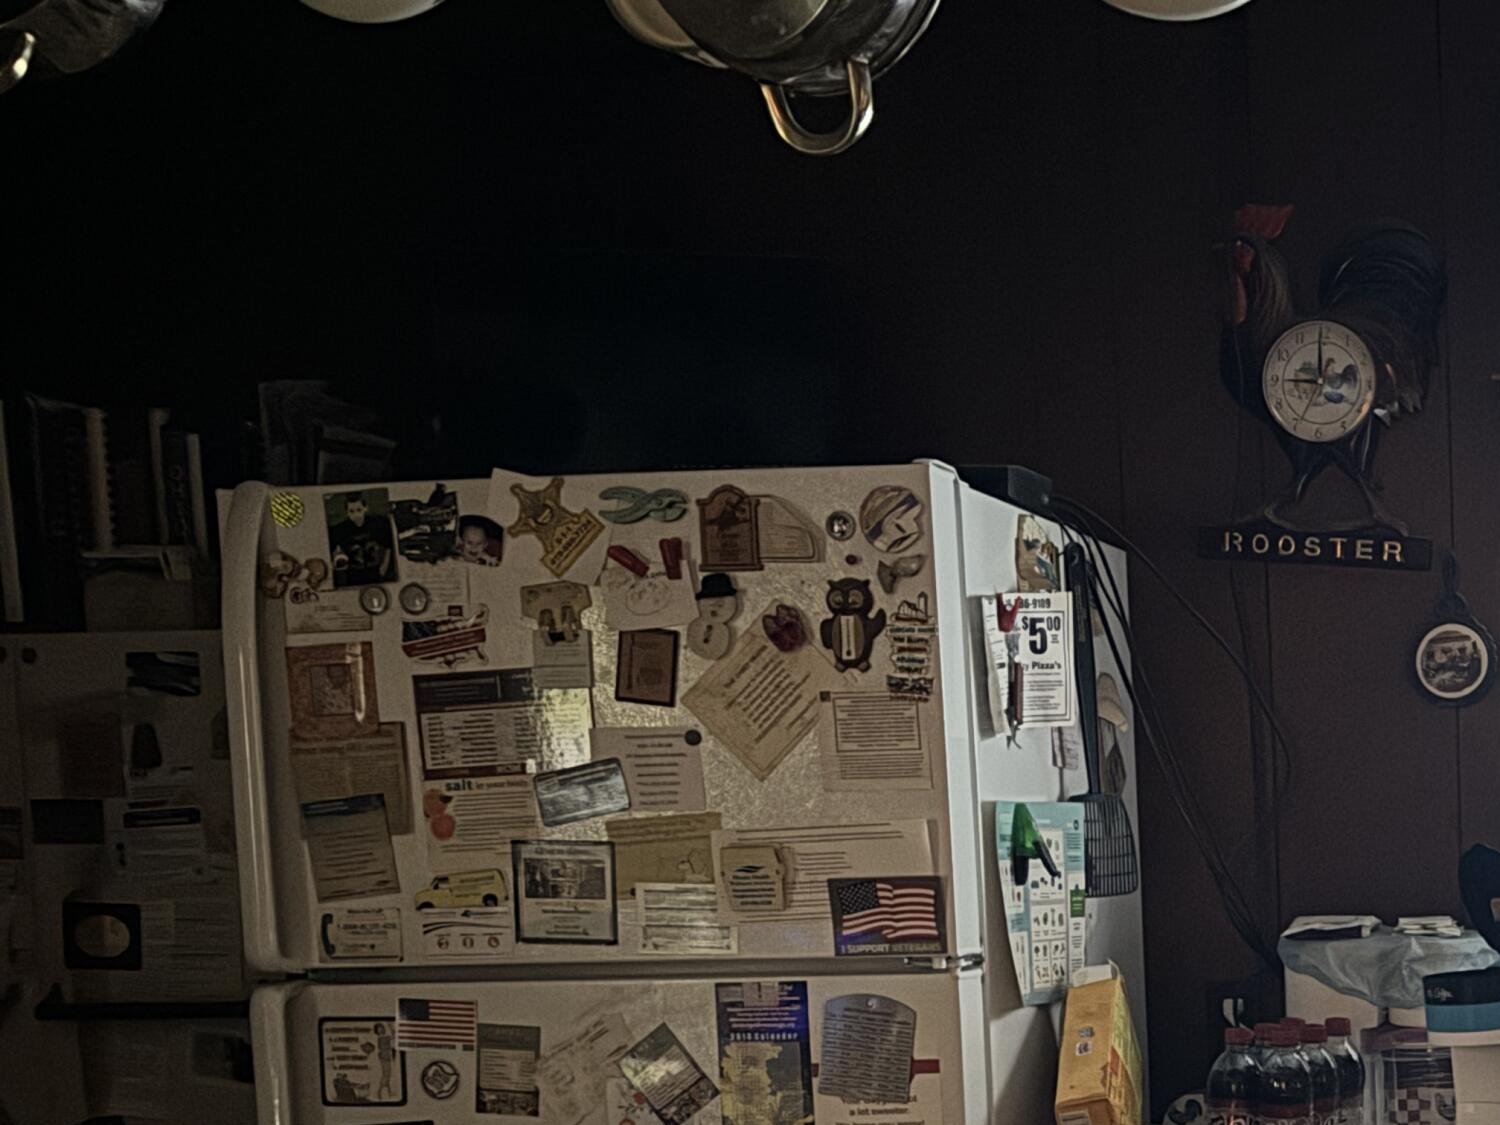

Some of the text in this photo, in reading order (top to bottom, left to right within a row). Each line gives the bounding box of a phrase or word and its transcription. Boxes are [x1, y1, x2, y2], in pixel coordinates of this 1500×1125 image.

[1271, 374, 1279, 386] 9
[1223, 531, 1403, 563] ROOSTER
[445, 780, 472, 791] salt
[847, 944, 890, 954] SUPPORT
